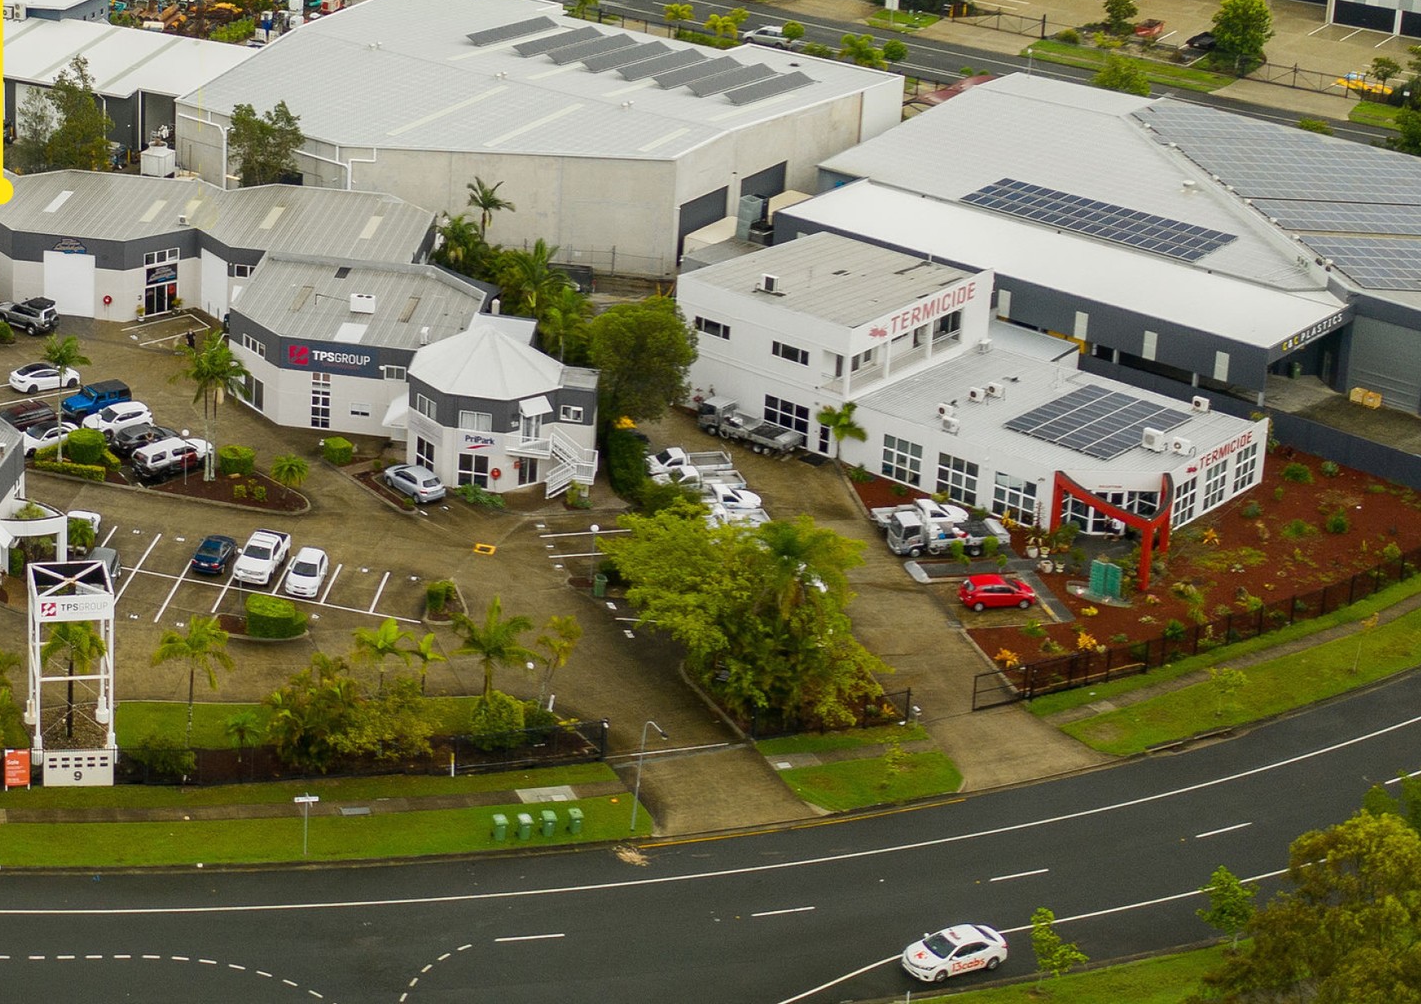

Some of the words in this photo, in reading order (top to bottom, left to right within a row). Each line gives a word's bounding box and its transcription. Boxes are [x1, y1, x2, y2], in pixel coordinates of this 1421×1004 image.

[891, 282, 976, 334] TERMICIDE
[1301, 313, 1343, 342] PLASTICS
[312, 350, 371, 366] TPSGROUP
[465, 434, 495, 445] PriPark
[1200, 431, 1253, 470] TERMICIDE
[61, 601, 109, 612] TPSGROUP
[73, 771, 82, 781] 9
[952, 957, 986, 972] 13cabs
